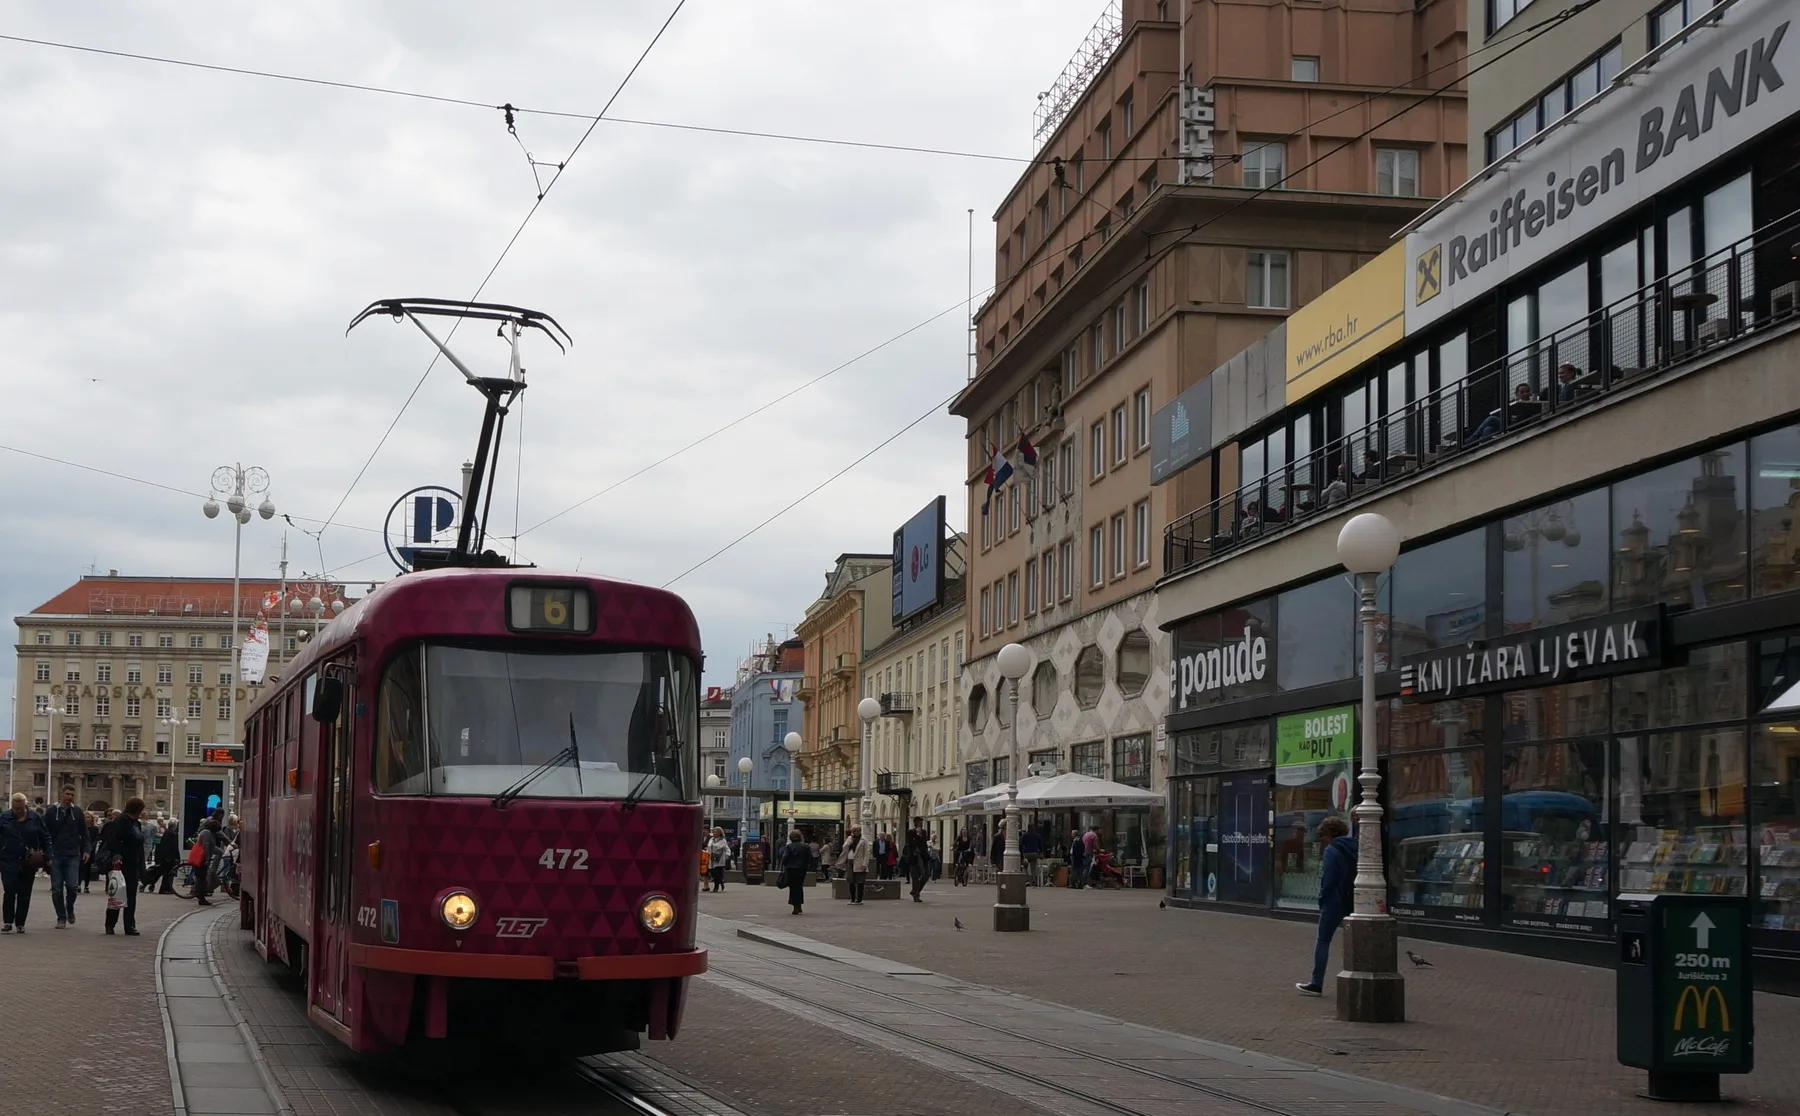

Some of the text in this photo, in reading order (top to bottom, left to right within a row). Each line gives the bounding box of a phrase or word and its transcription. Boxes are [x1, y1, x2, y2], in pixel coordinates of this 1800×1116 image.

[1192, 87, 1218, 181] HOTEL
[1447, 20, 1791, 287] Raiffeisen BANK
[1294, 313, 1361, 368] www.rba.hr
[544, 591, 567, 625] 6
[1179, 626, 1266, 708] ponude
[1418, 619, 1640, 696] KNJIŽARA LJEVAK
[51, 684, 155, 700] GRADSKA
[1304, 713, 1348, 739] BOLEST
[1311, 737, 1333, 759] PUT
[538, 848, 589, 870] 472
[357, 905, 377, 929] 472
[496, 917, 549, 939] ZET
[1674, 952, 1731, 968] 250 m
[1677, 971, 1720, 980] Jurišićeva
